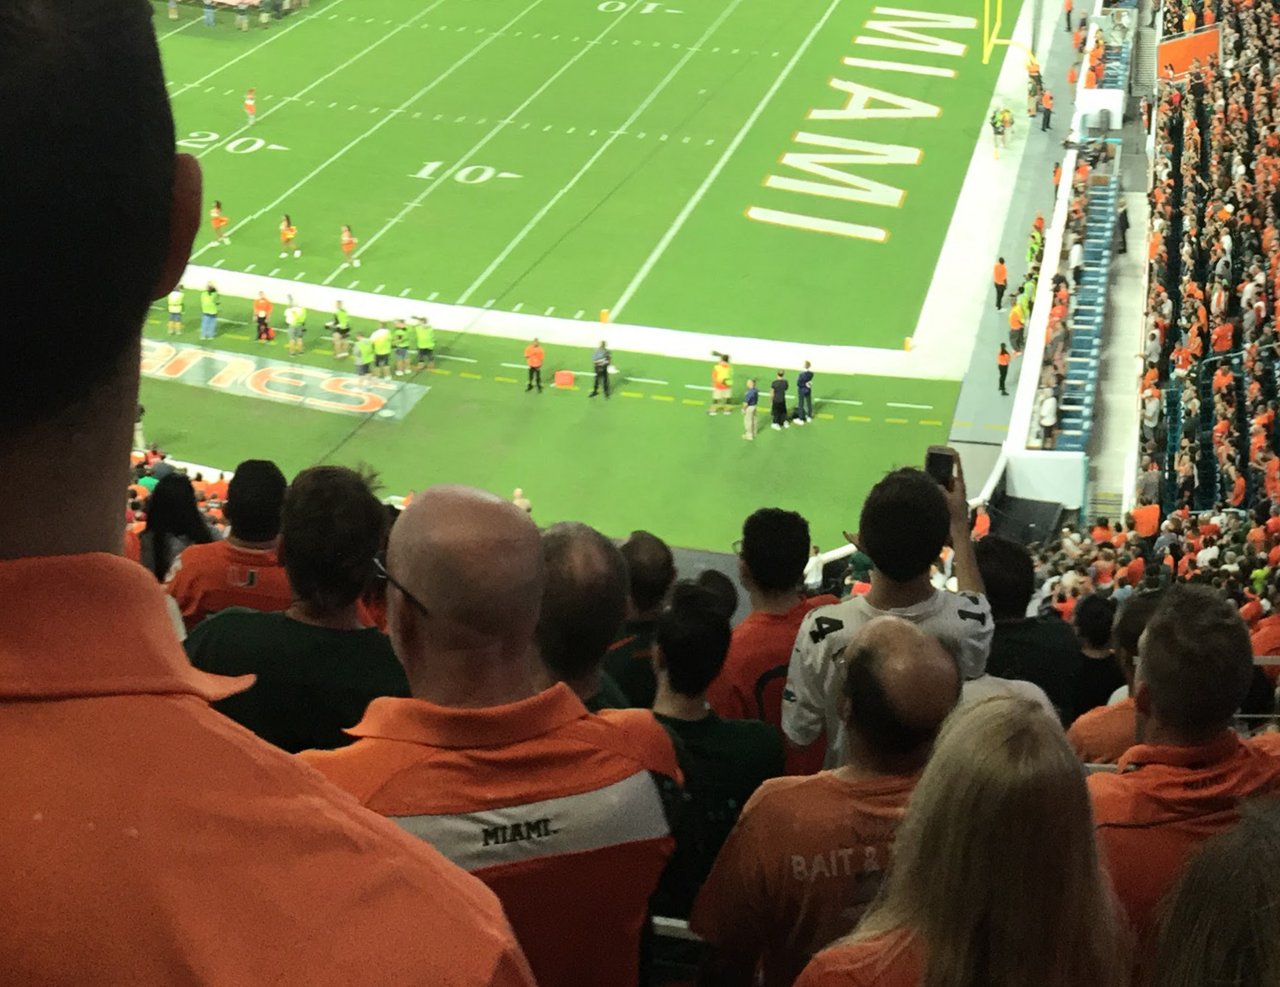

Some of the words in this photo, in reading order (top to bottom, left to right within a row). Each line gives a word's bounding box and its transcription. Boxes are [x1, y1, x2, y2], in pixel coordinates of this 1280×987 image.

[744, 6, 978, 244] MIAMI
[175, 130, 266, 154] 20
[407, 160, 496, 184] 10
[809, 616, 844, 644] 4
[791, 848, 854, 882] BAIT
